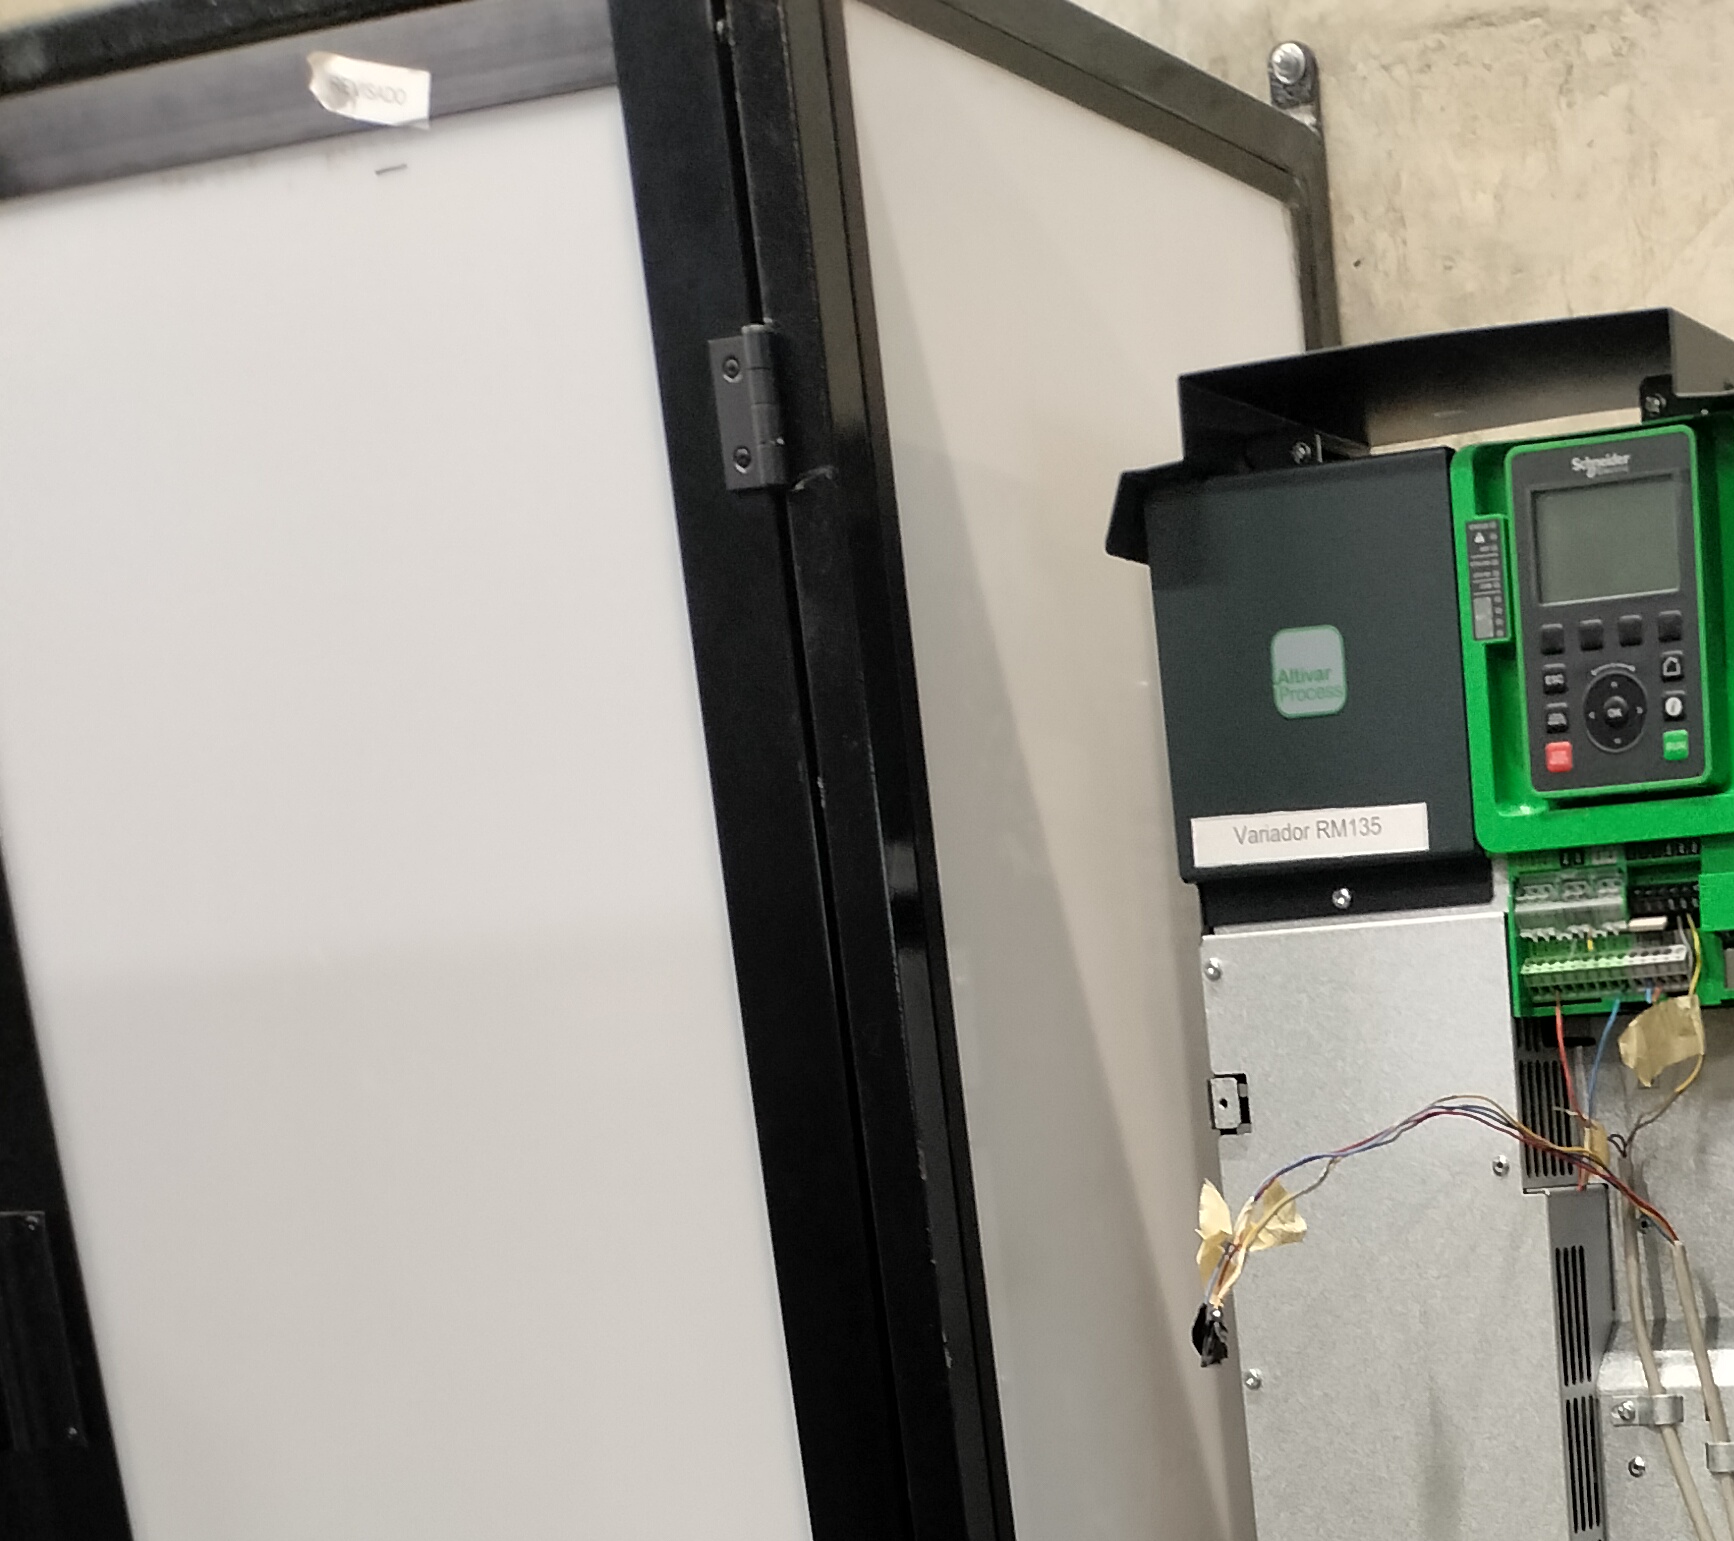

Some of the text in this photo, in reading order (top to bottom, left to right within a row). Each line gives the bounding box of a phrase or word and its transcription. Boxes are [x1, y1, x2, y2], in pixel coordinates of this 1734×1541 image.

[1279, 668, 1331, 683] Altivar
[1280, 684, 1343, 702] Process
[1233, 816, 1382, 845] Variador RM135
